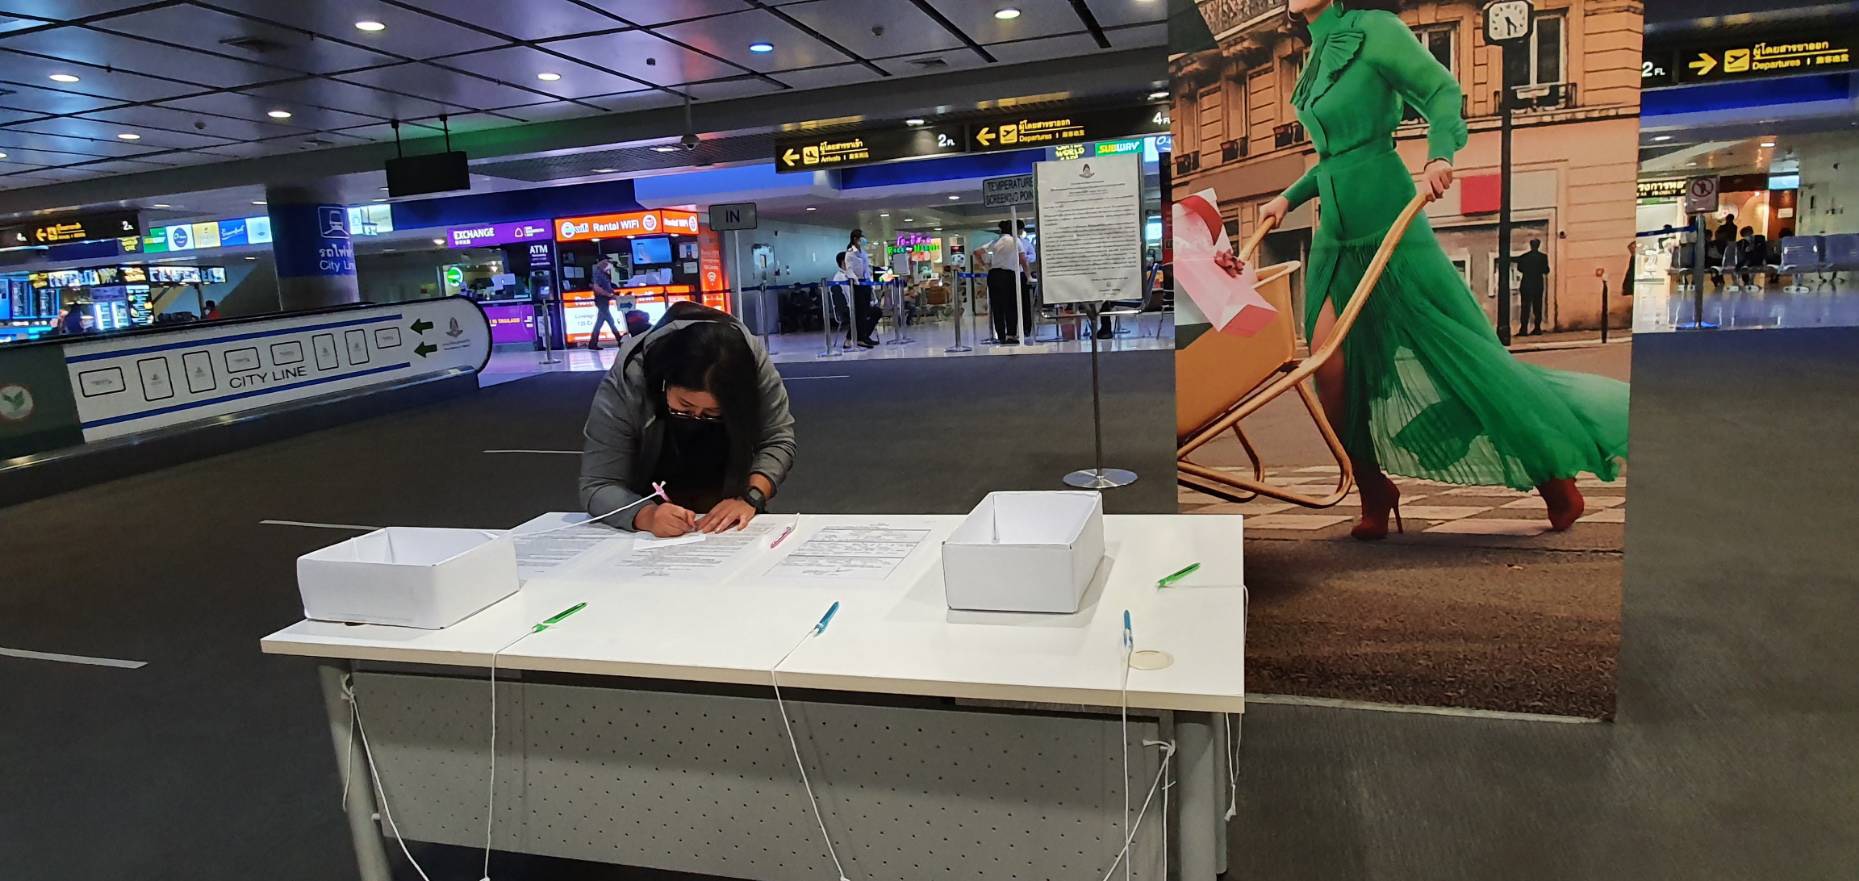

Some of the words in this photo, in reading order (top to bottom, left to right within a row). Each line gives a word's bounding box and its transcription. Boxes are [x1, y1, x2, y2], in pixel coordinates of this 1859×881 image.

[1752, 58, 1801, 70] Departures
[1019, 133, 1052, 142] Departures
[1099, 142, 1140, 153] SUBWAY
[1020, 190, 1034, 201] POIN
[725, 209, 741, 223] IN
[592, 221, 619, 232] Rental
[453, 227, 496, 240] EXCHANGE
[529, 244, 549, 255] ATM
[319, 260, 341, 273] City
[229, 372, 268, 389] CITY
[272, 365, 308, 382] LINE
